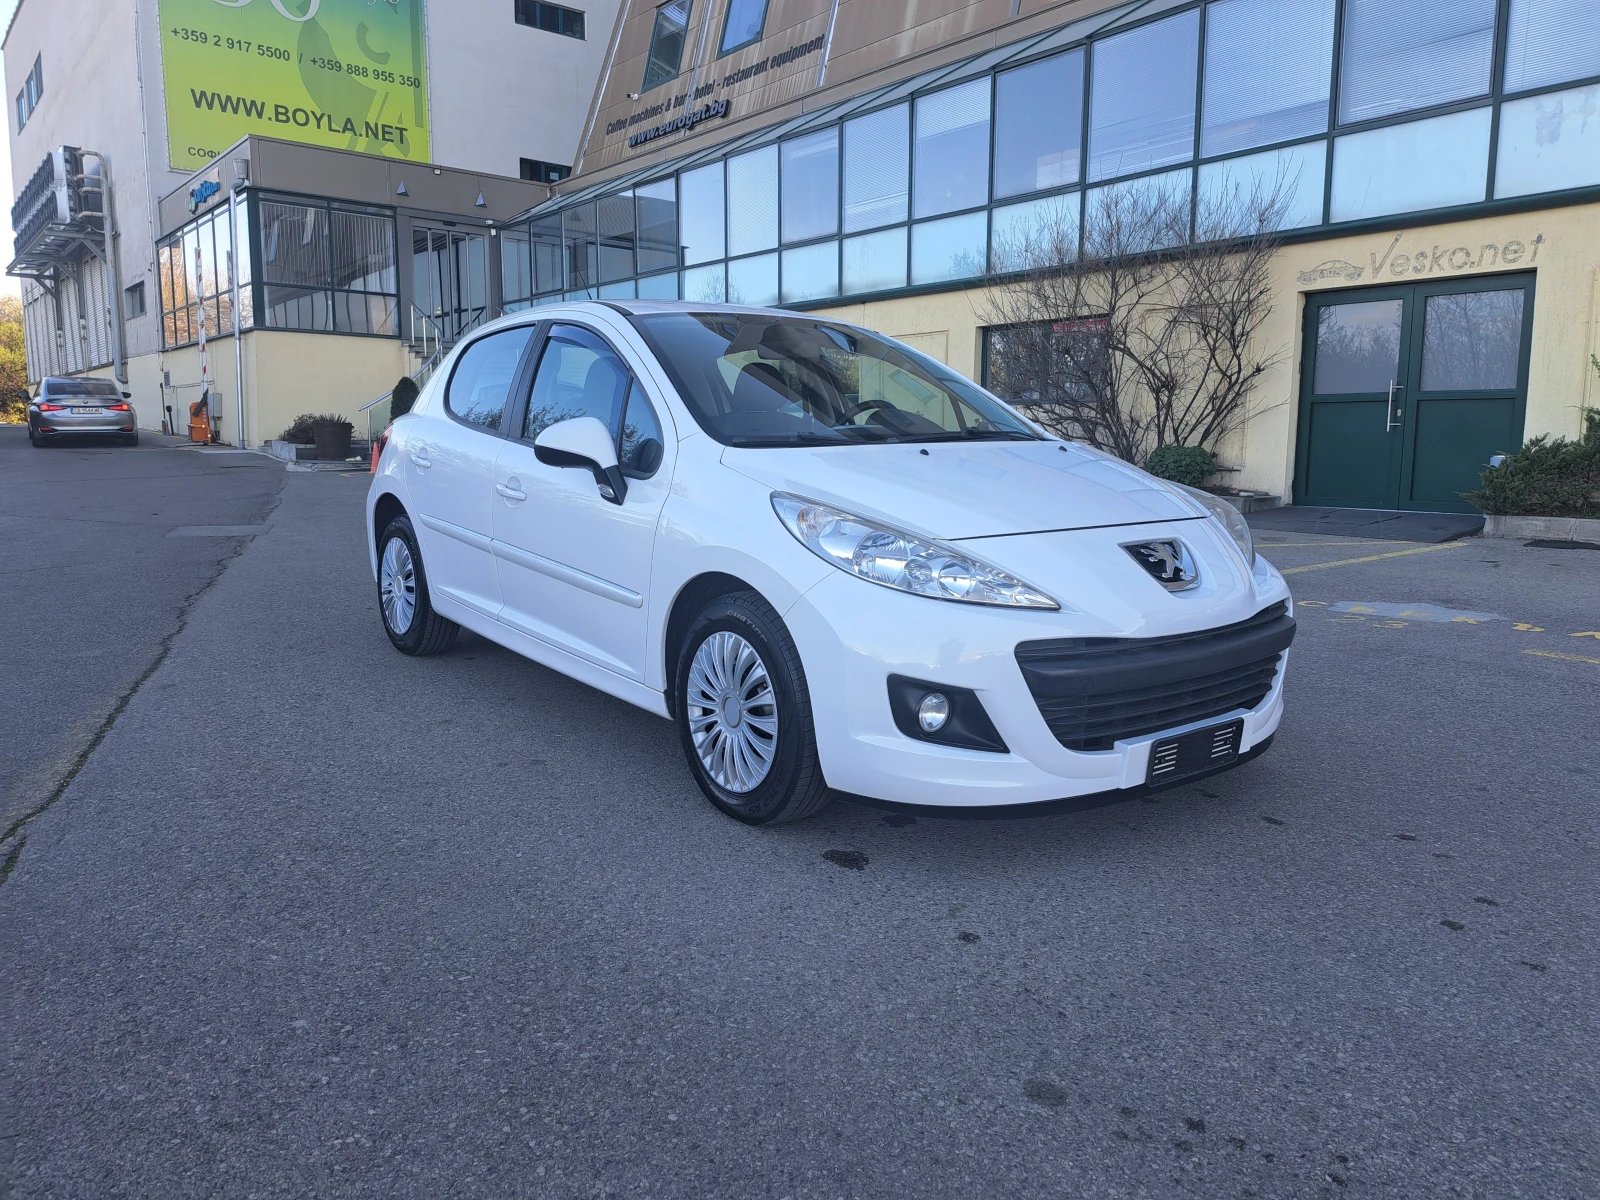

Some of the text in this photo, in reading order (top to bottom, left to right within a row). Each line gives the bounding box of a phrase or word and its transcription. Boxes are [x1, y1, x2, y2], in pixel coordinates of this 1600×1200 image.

[171, 27, 421, 89] +359 2 917 5500 / +359 888 955 350
[606, 118, 628, 136] Coffee
[628, 102, 664, 127] machines
[665, 97, 672, 112] &
[673, 94, 688, 109] bar
[693, 79, 716, 101] hotel
[722, 56, 769, 89] restaurant
[770, 33, 825, 69] equipment
[190, 88, 408, 145] WWW.BOYLA.NET
[628, 99, 730, 148] www.eurogat.bg
[1370, 232, 1546, 280] Vesko.net
